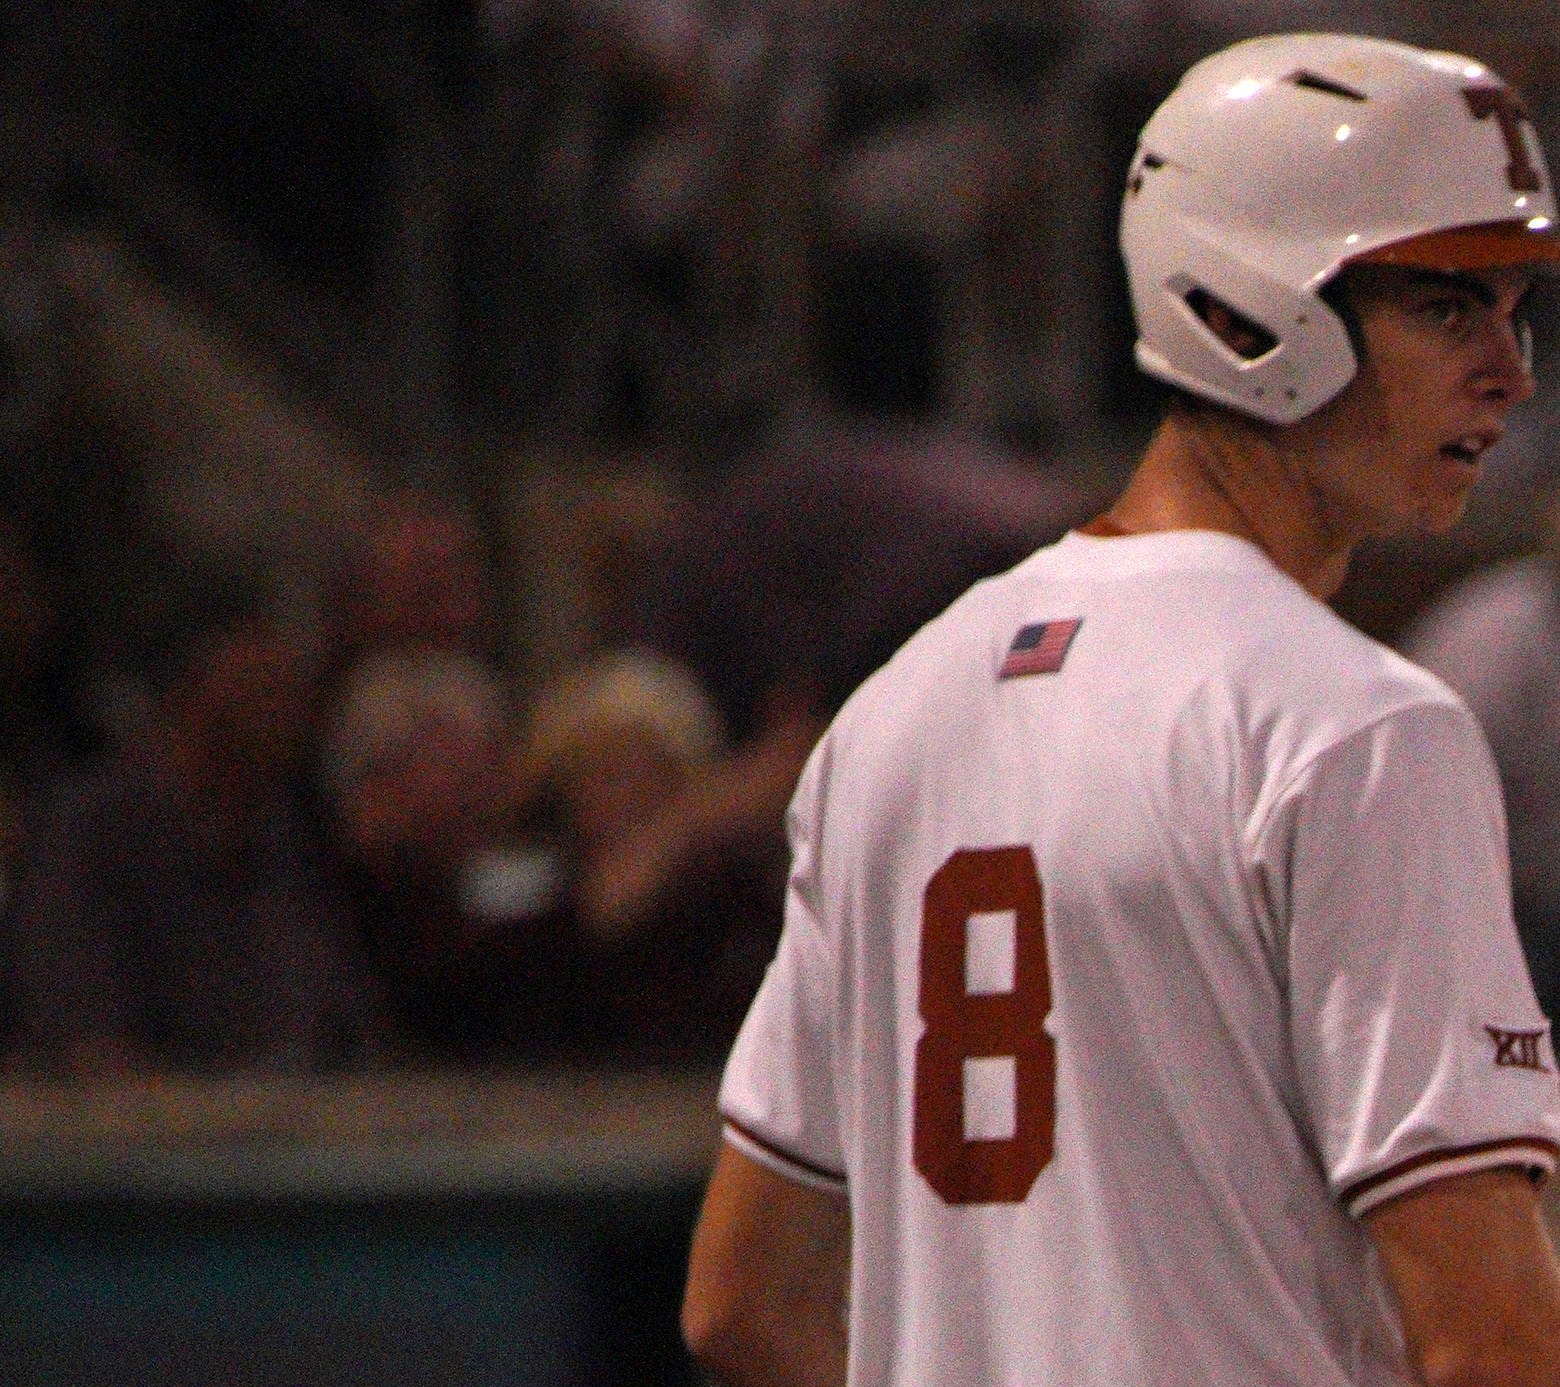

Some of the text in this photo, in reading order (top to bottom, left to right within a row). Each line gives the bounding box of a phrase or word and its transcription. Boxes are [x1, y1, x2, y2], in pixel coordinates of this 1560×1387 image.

[1461, 86, 1542, 192] T
[912, 844, 1058, 1206] 8
[1482, 1022, 1550, 1074] XII
